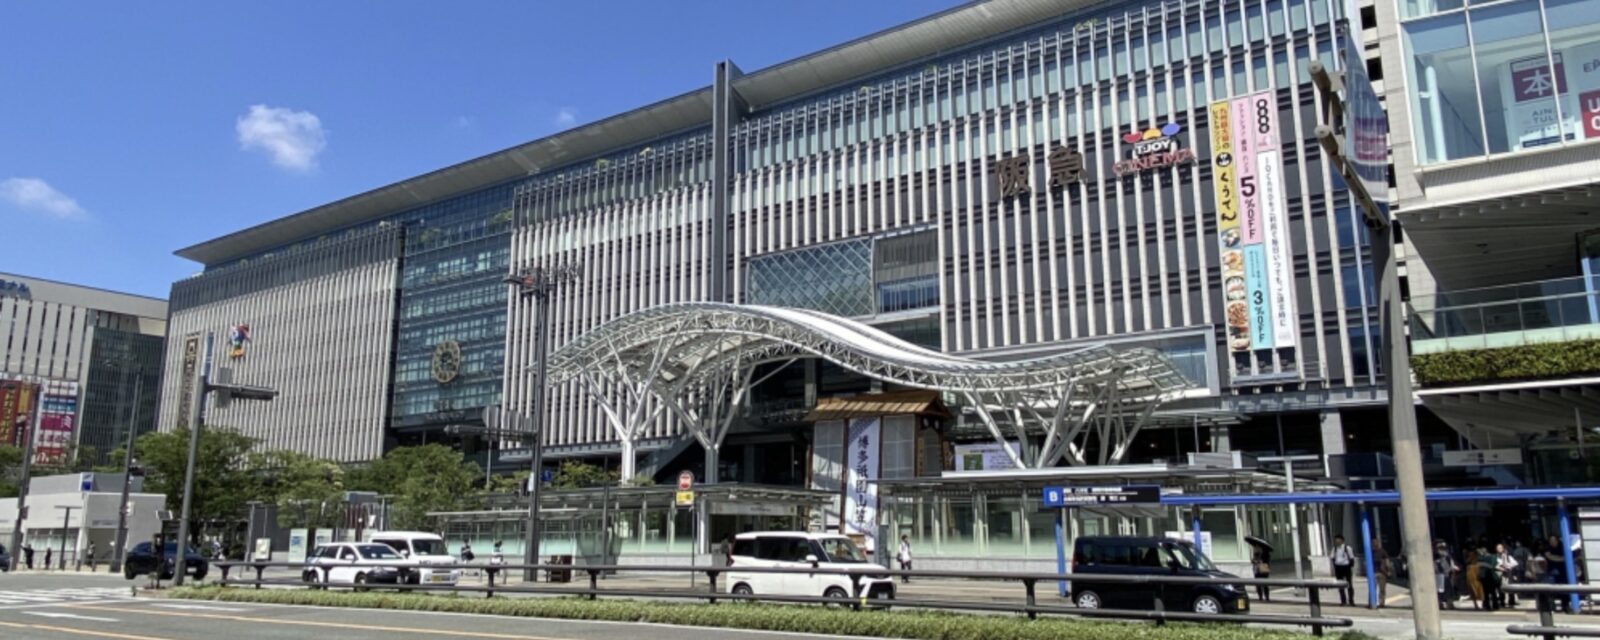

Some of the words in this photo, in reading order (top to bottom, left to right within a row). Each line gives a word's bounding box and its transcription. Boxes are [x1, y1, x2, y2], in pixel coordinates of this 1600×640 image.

[1521, 69, 1553, 96] 本
[996, 145, 1088, 198] 阪急
[1112, 148, 1196, 174] CINEMA
[1220, 171, 1237, 222] くうてん
[1240, 175, 1257, 240] 5%OFF
[1252, 290, 1265, 343] 3%OFF
[1049, 490, 1058, 502] B
